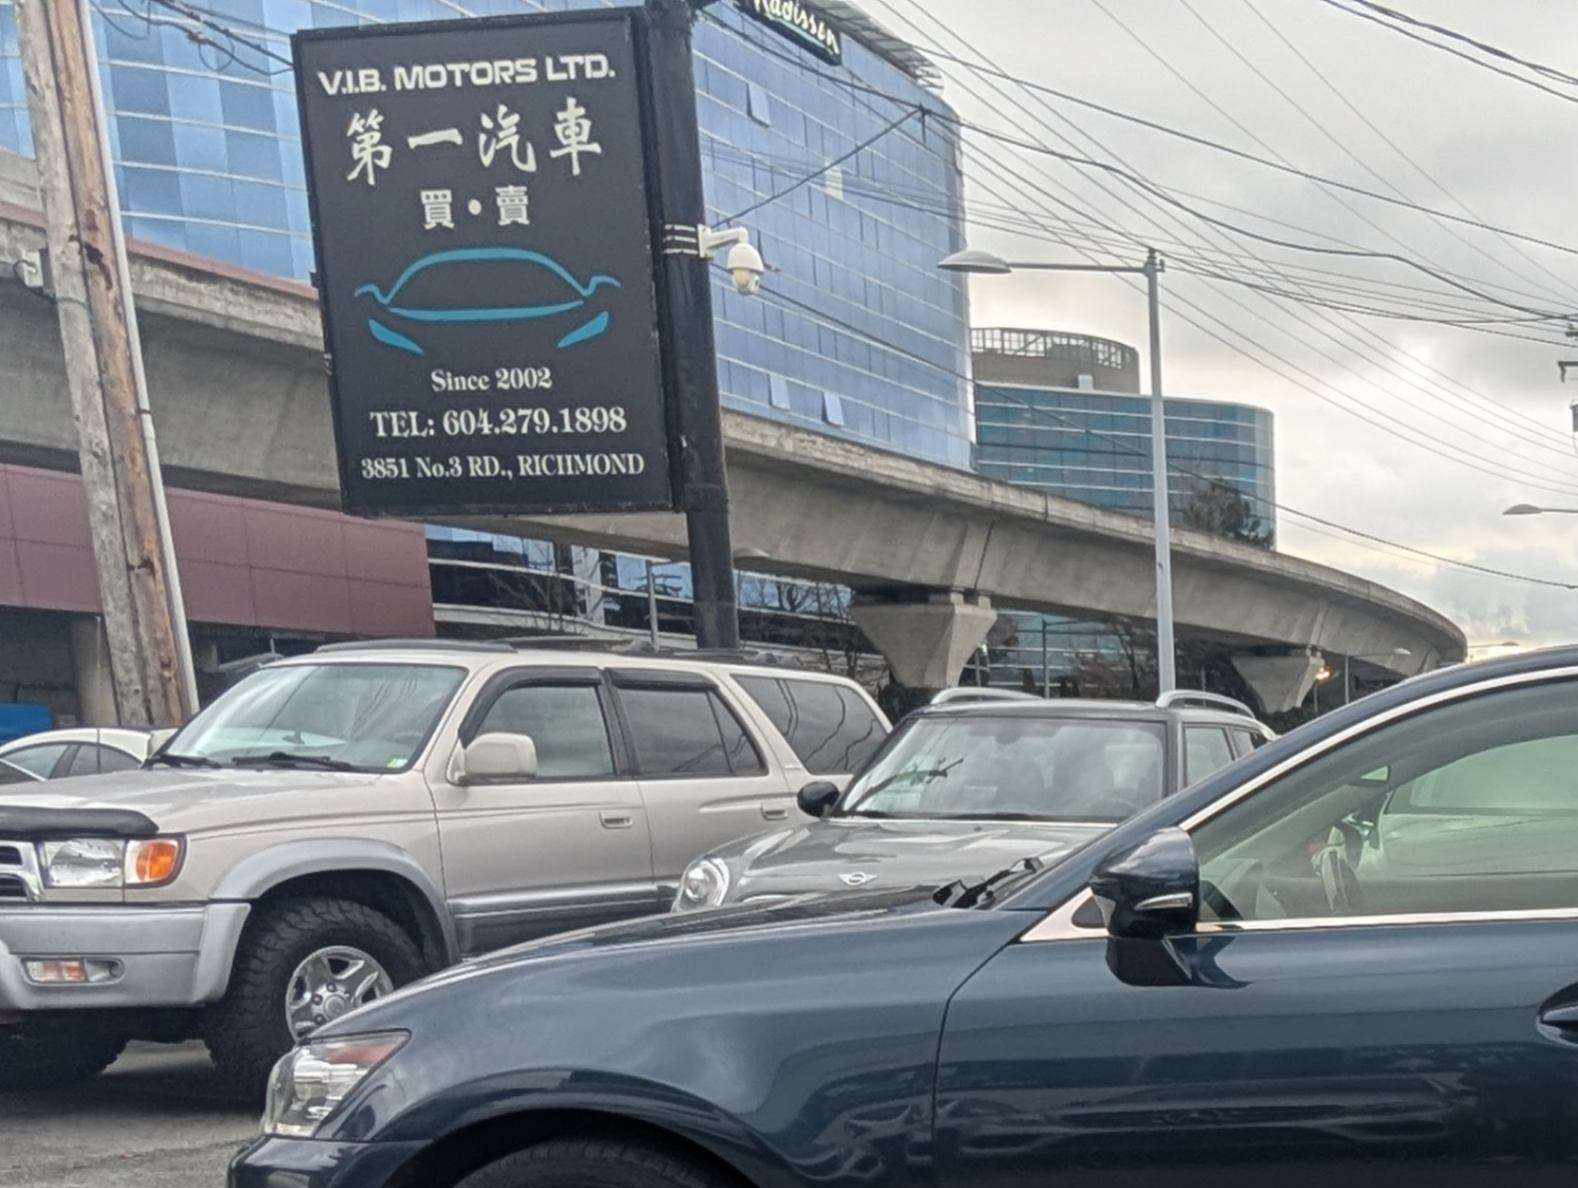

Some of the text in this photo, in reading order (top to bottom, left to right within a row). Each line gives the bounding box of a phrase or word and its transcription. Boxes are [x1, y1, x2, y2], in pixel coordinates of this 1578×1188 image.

[317, 53, 617, 96] V.I.B. MOTORS LTD.
[346, 96, 603, 186] 第一汽車
[431, 366, 553, 392] Since 2002
[369, 406, 627, 438] TEL: 604.279.1898
[361, 453, 645, 480] 3851 No.3 RD., RICHMOND
